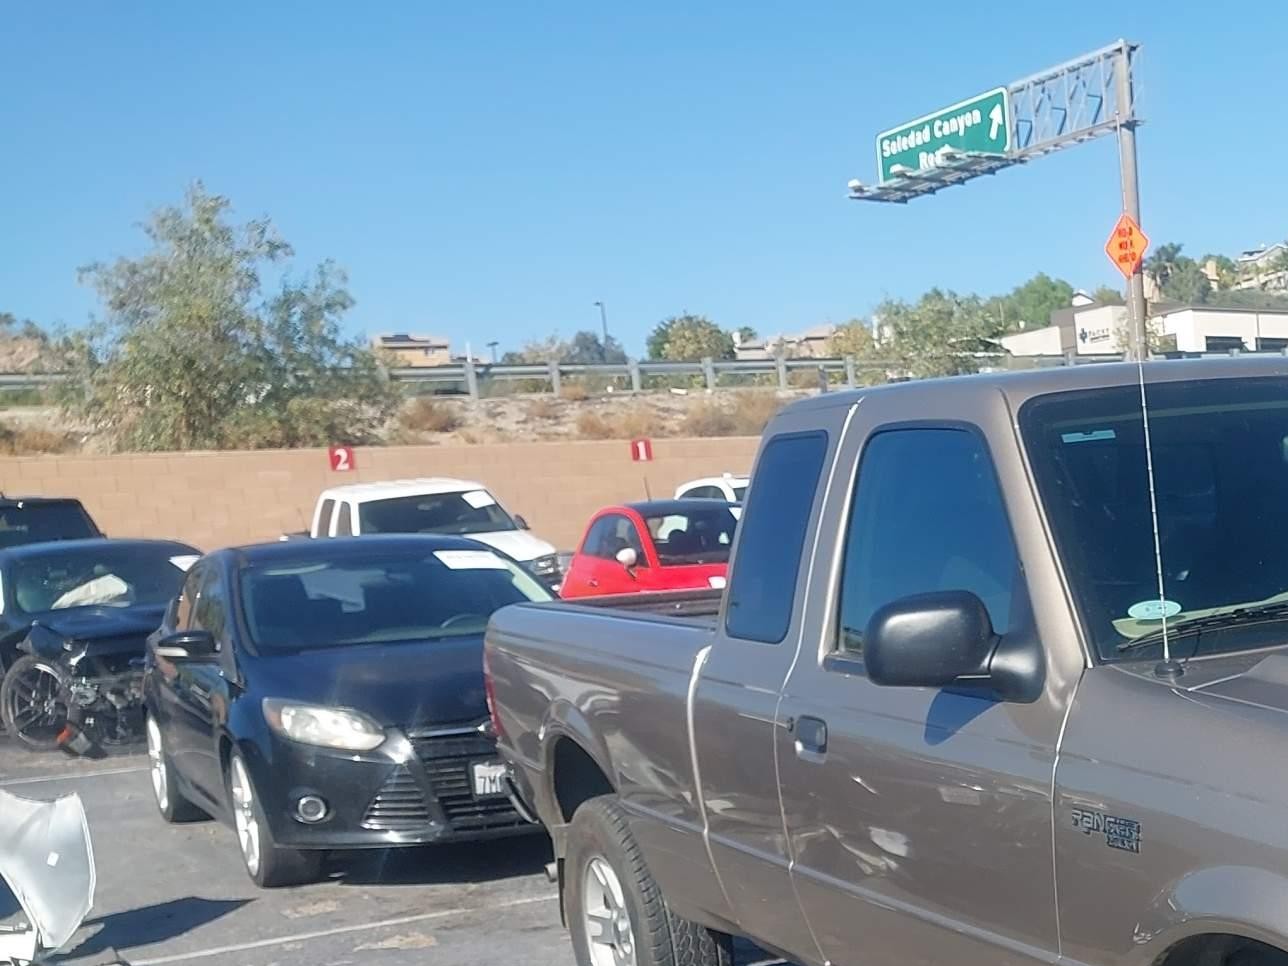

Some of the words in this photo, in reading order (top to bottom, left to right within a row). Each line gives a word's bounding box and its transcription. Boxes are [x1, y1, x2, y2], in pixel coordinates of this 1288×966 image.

[882, 124, 931, 158] Soledad
[933, 108, 982, 138] Canyon
[334, 448, 349, 470] 2
[637, 440, 647, 460] 1
